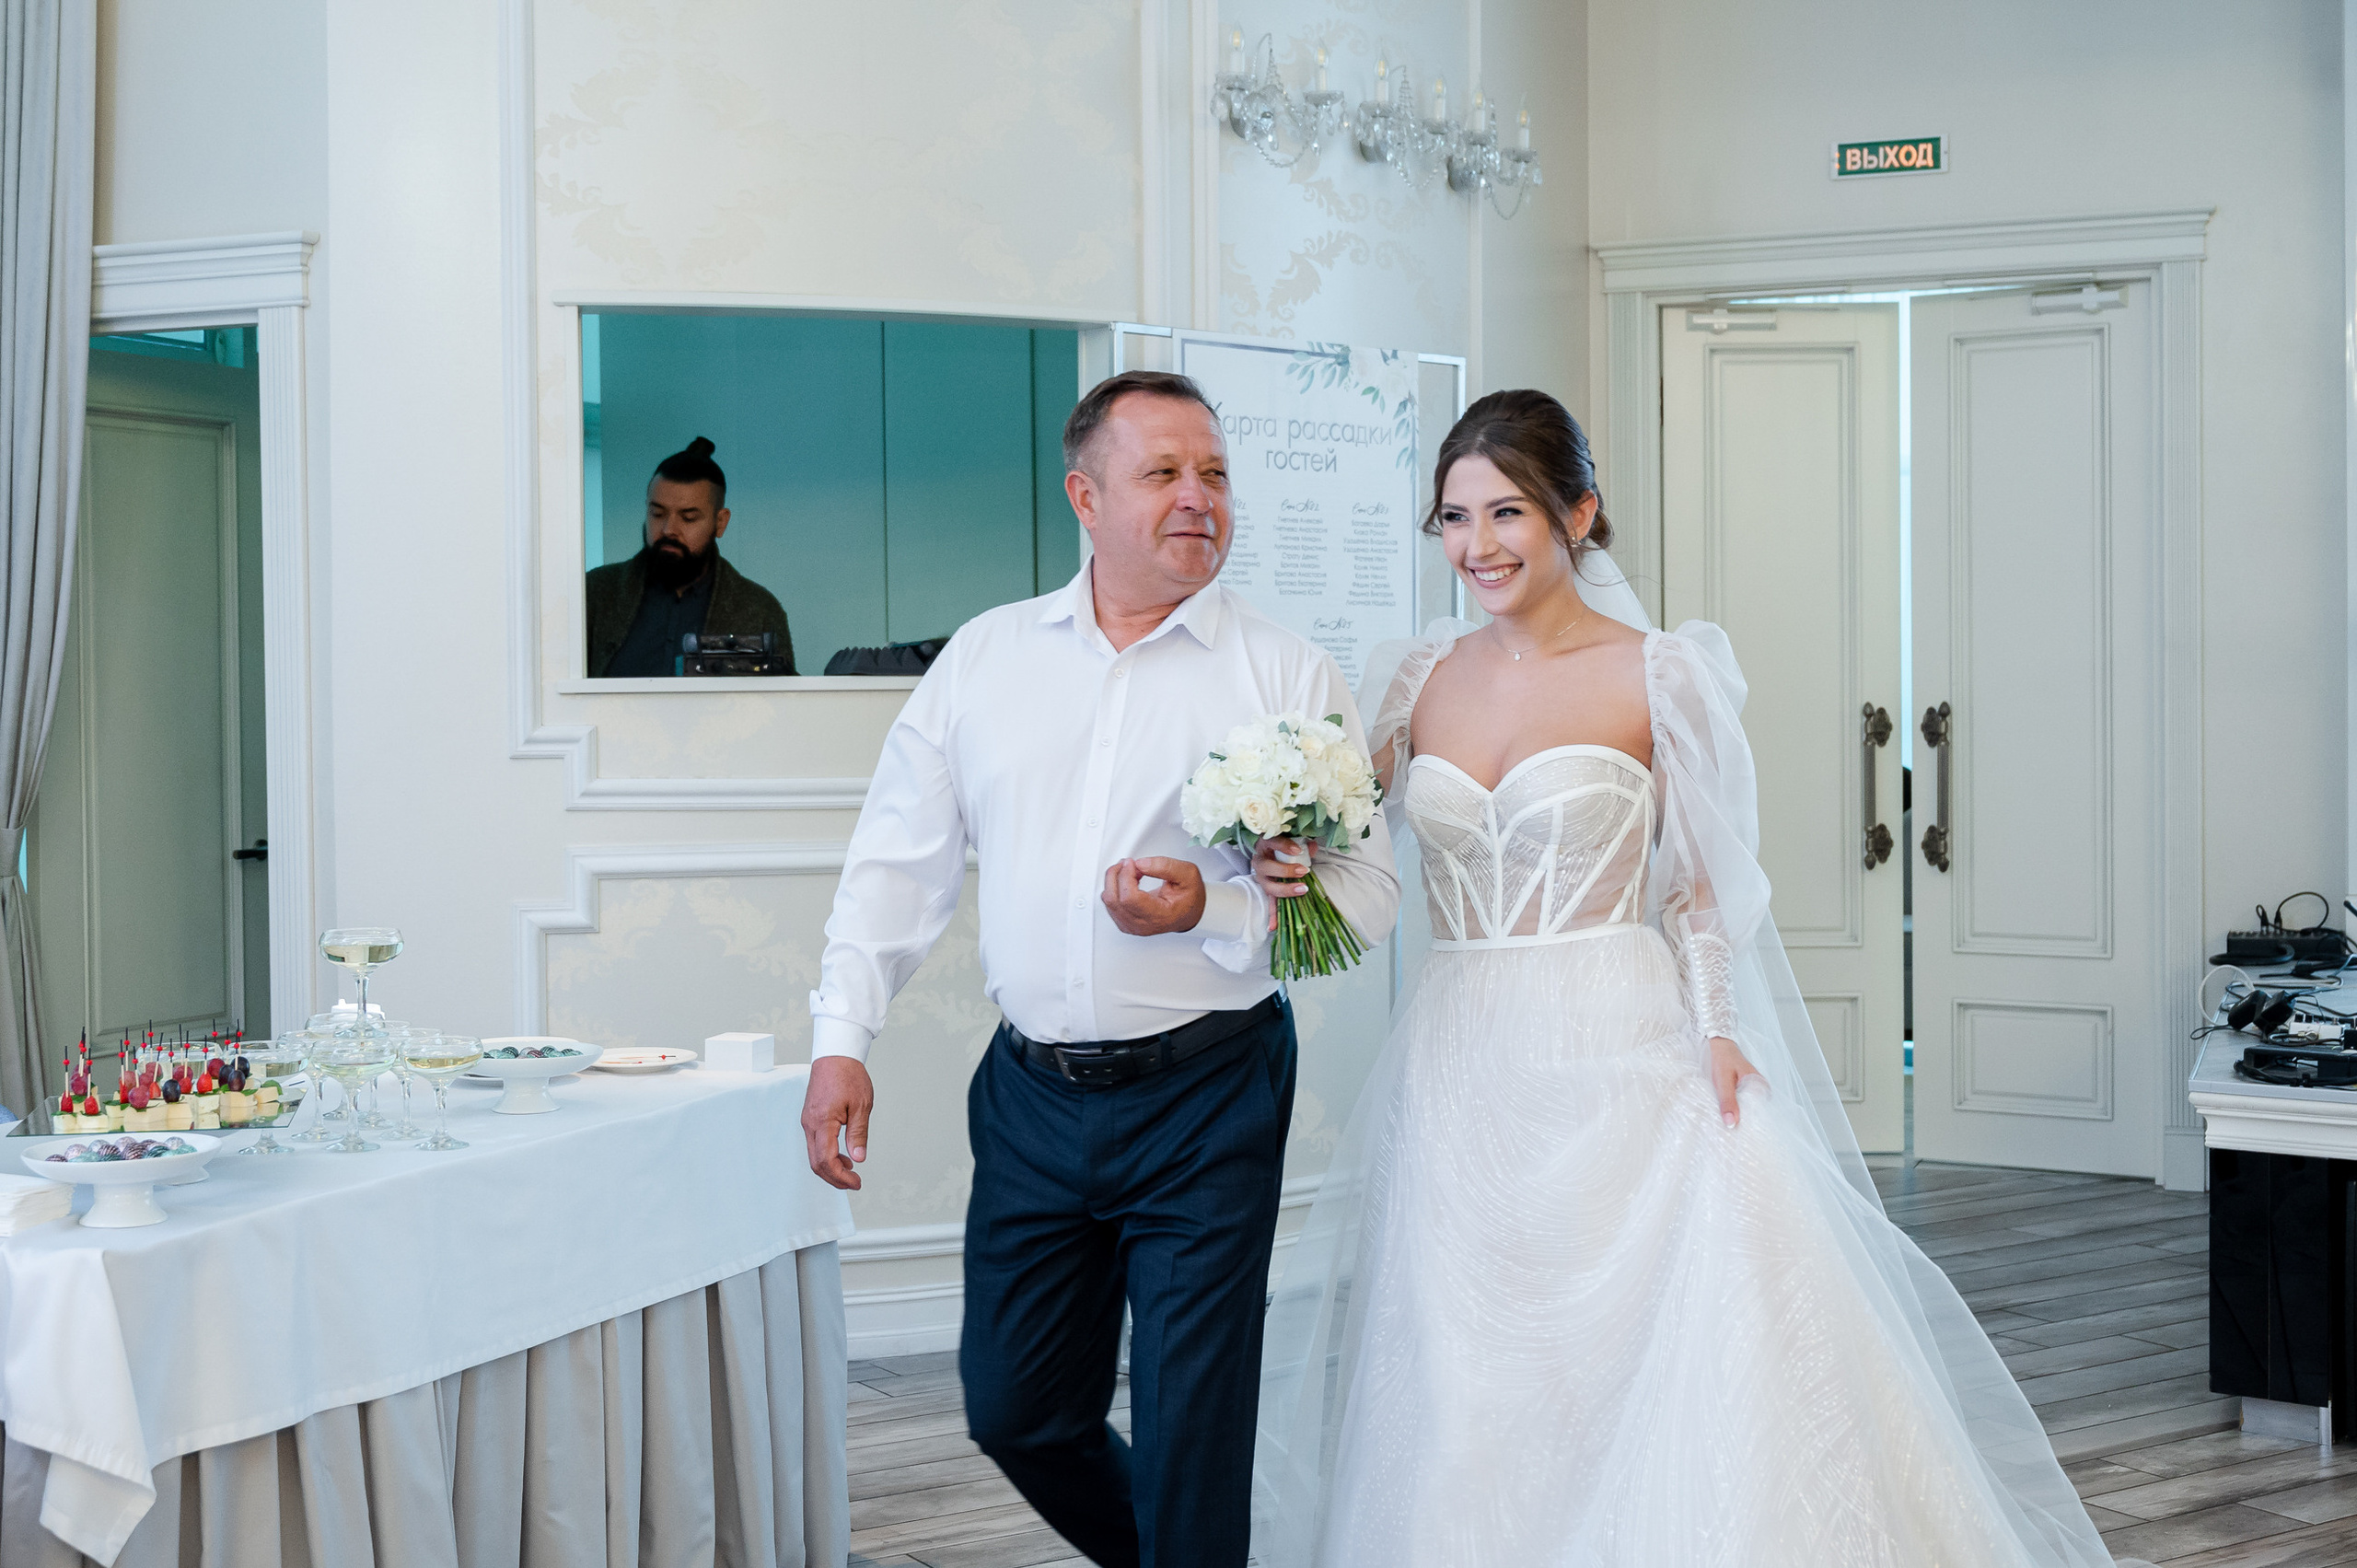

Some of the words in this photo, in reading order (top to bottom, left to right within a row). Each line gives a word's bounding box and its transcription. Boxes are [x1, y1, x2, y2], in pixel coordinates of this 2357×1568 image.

[1845, 143, 1934, 170] ВЫХОД
[1288, 419, 1392, 449] рассадки
[1266, 447, 1337, 472] гостей
